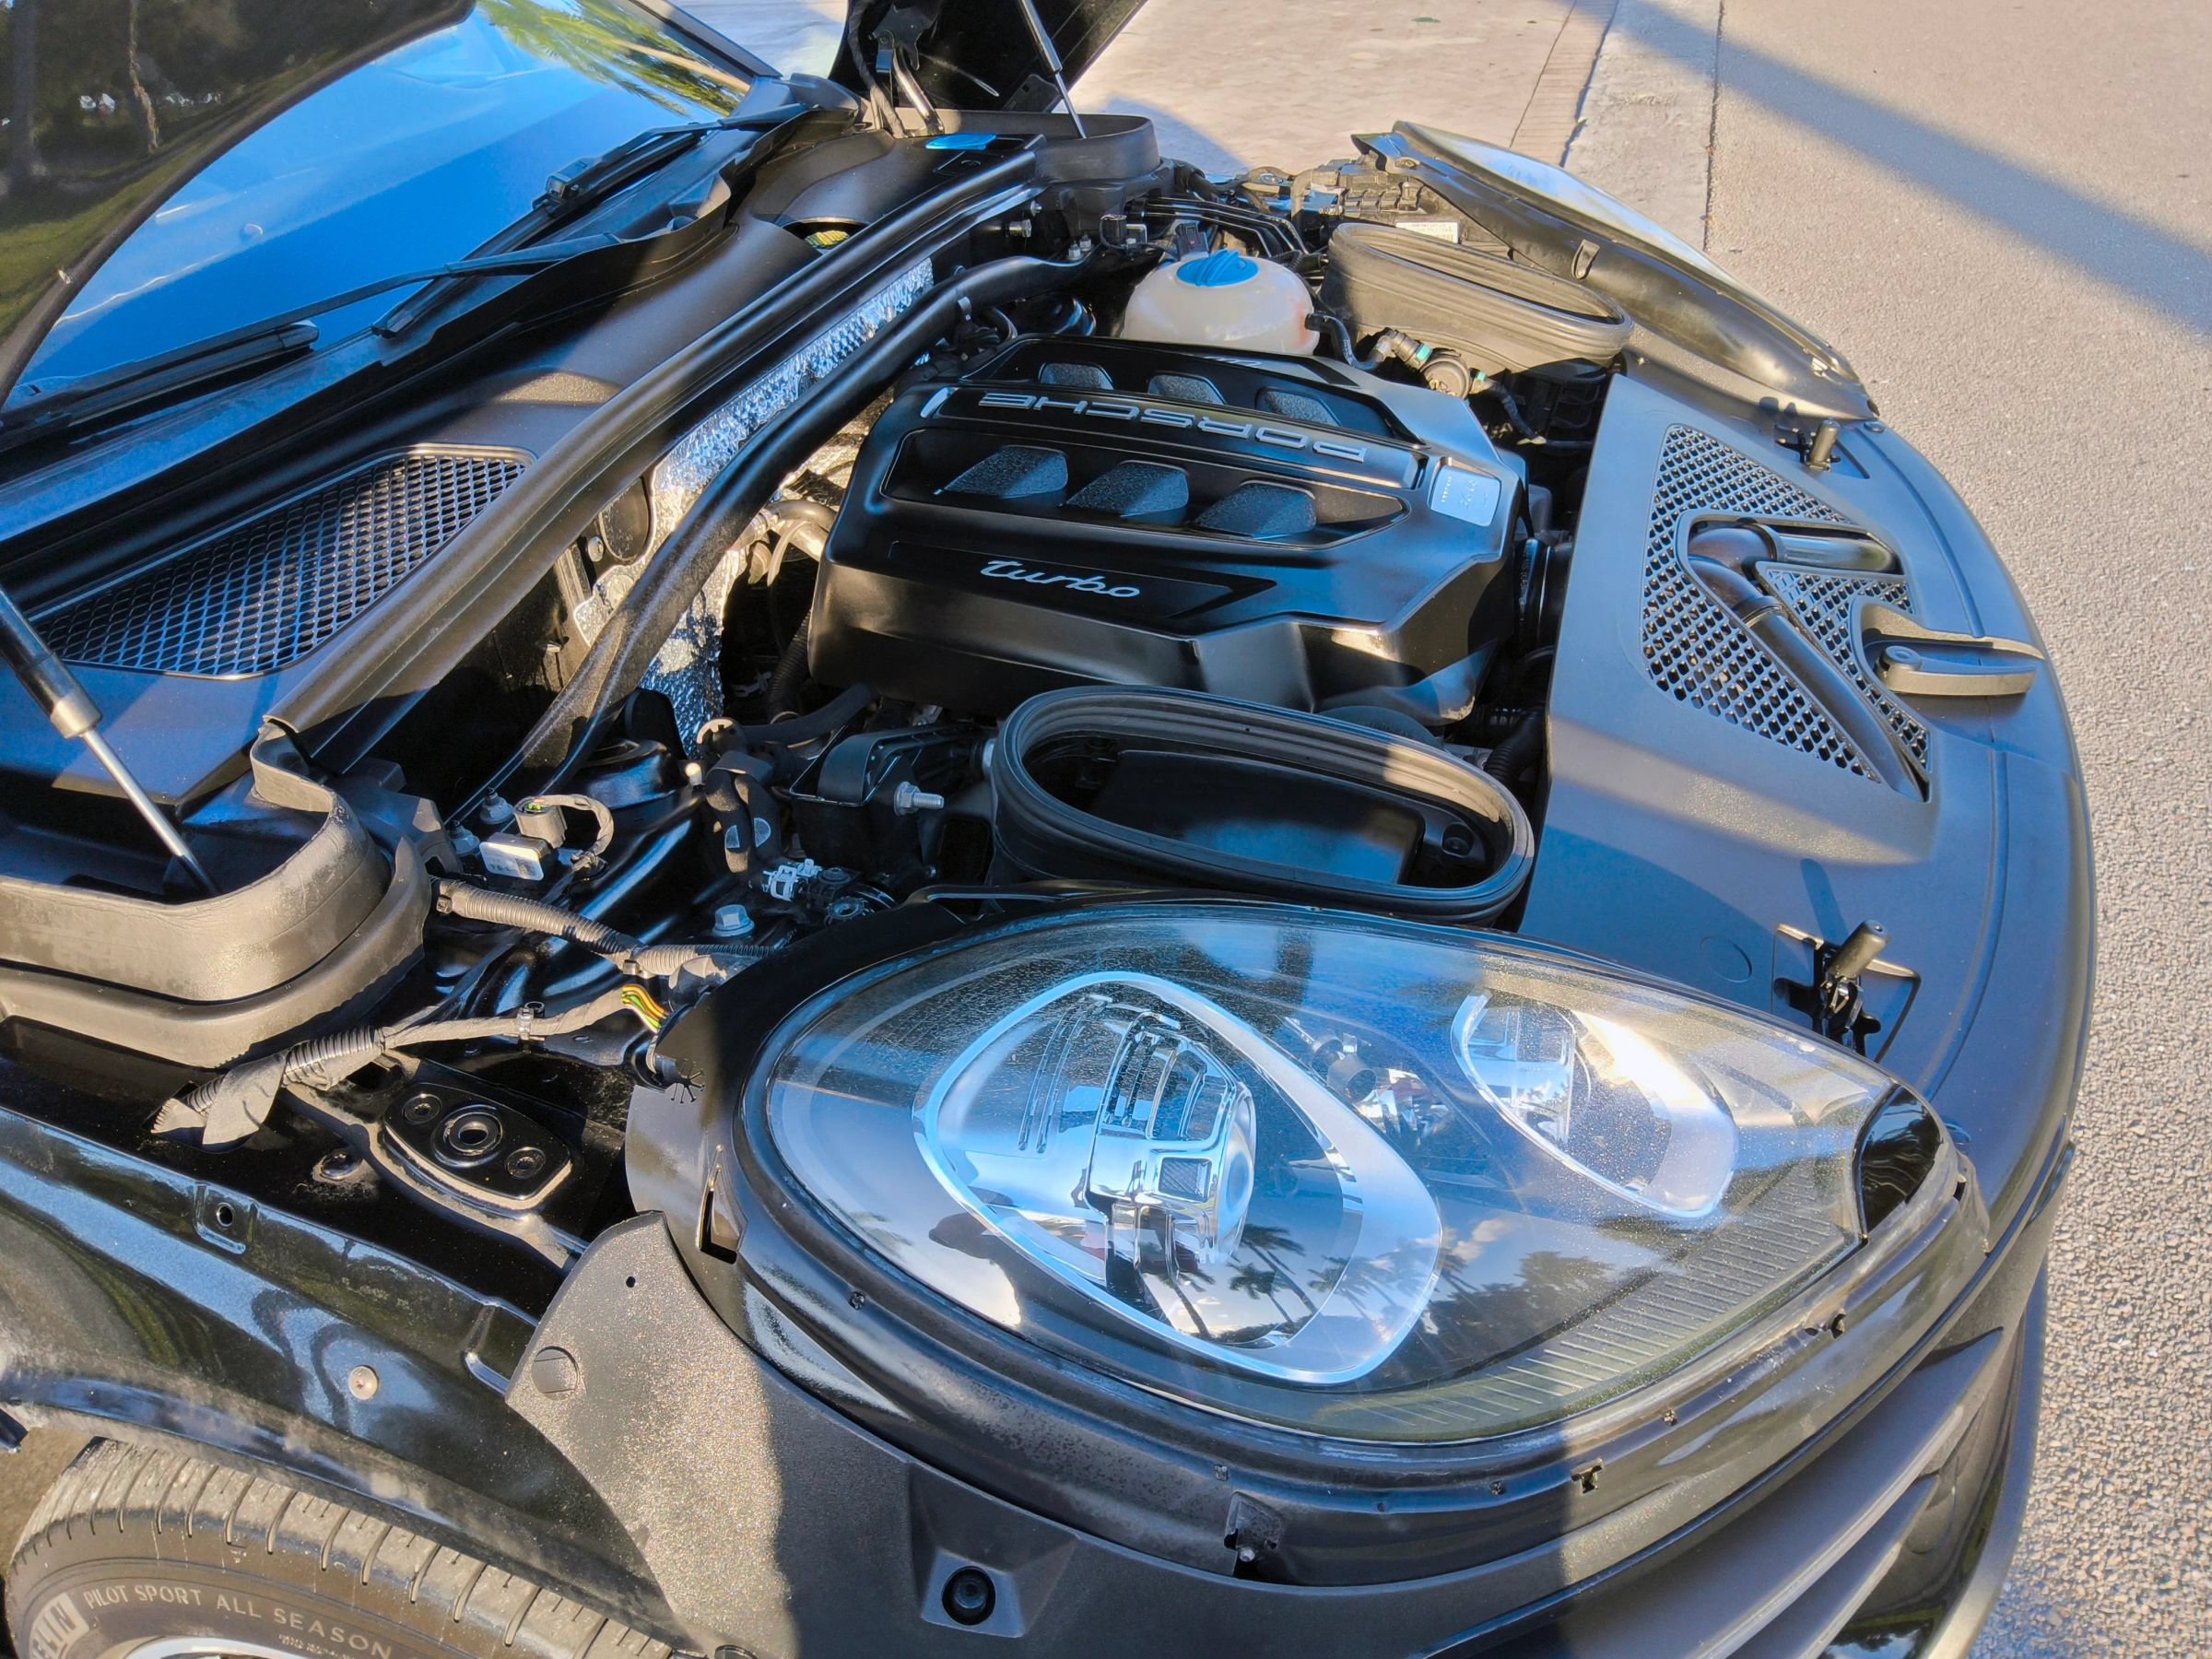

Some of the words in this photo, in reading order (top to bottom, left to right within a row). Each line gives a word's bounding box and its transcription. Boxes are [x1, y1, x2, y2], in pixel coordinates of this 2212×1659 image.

[978, 392, 1369, 464] PORSCHE
[82, 1584, 129, 1609] PILOT
[134, 1584, 202, 1606] SPORT
[216, 1594, 261, 1618] ALL
[273, 1607, 393, 1659] SEASON
